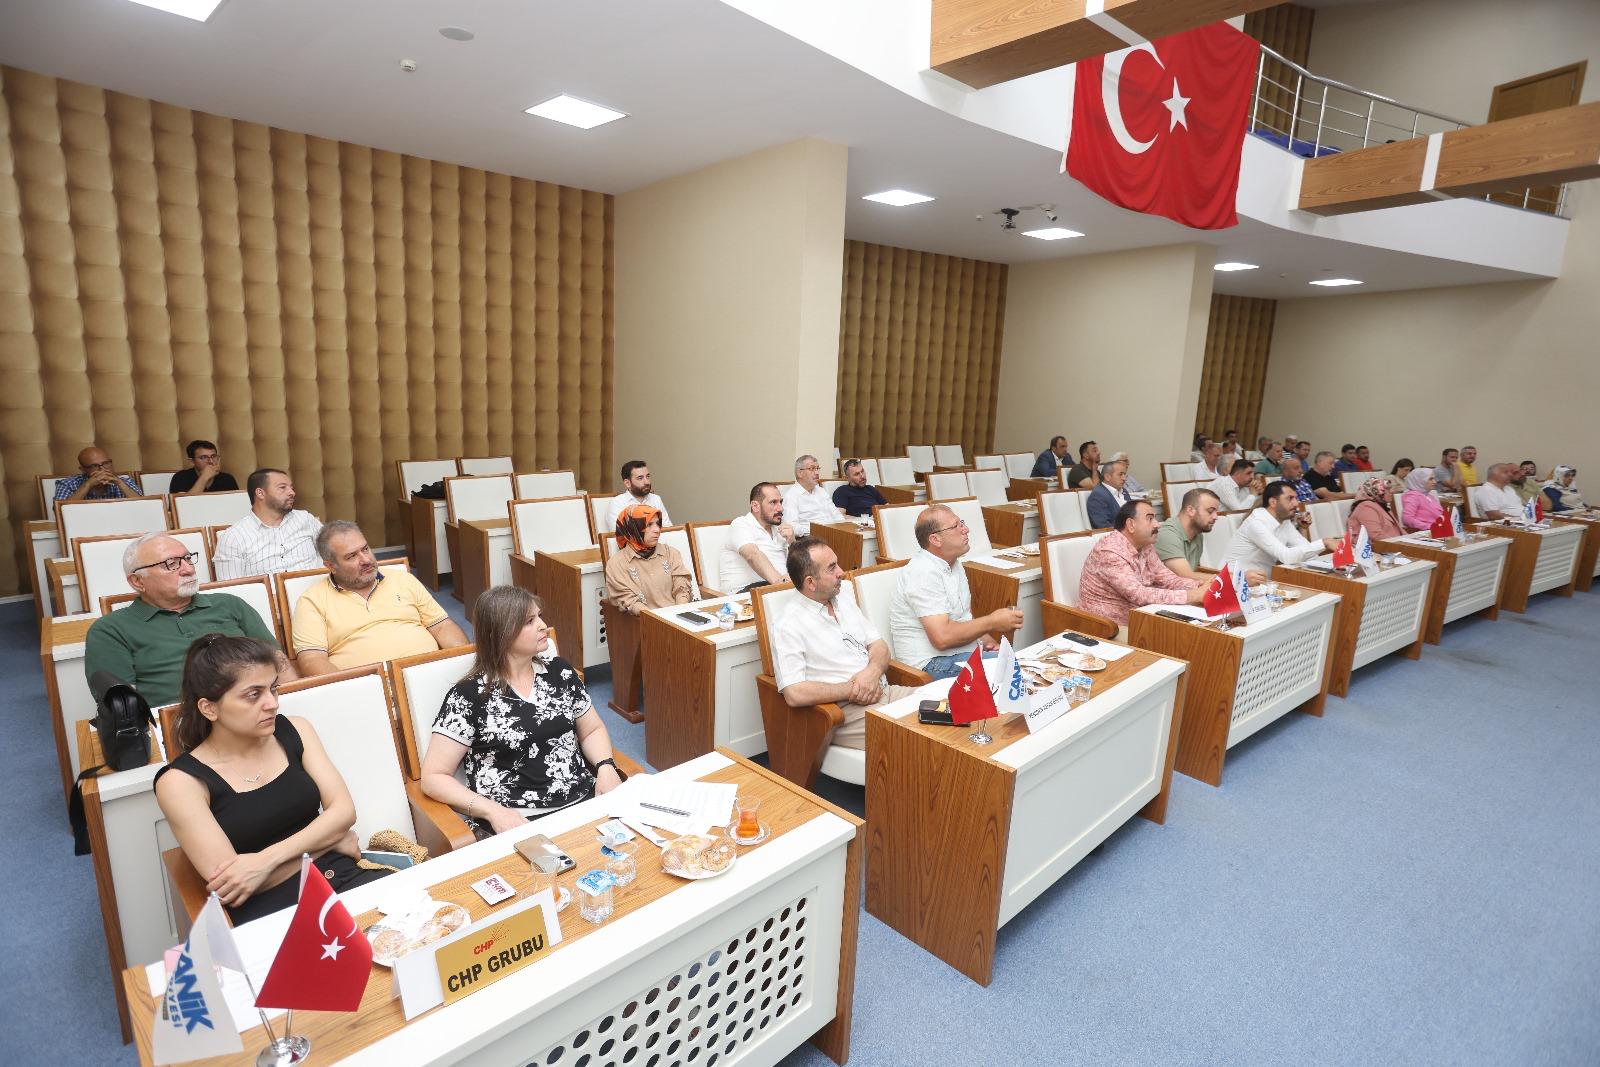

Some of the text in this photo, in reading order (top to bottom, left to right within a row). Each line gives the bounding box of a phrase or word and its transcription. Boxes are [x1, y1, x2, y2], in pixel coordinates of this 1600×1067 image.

[447, 933, 544, 992] CHP GRUBU
[473, 939, 494, 955] CHP
